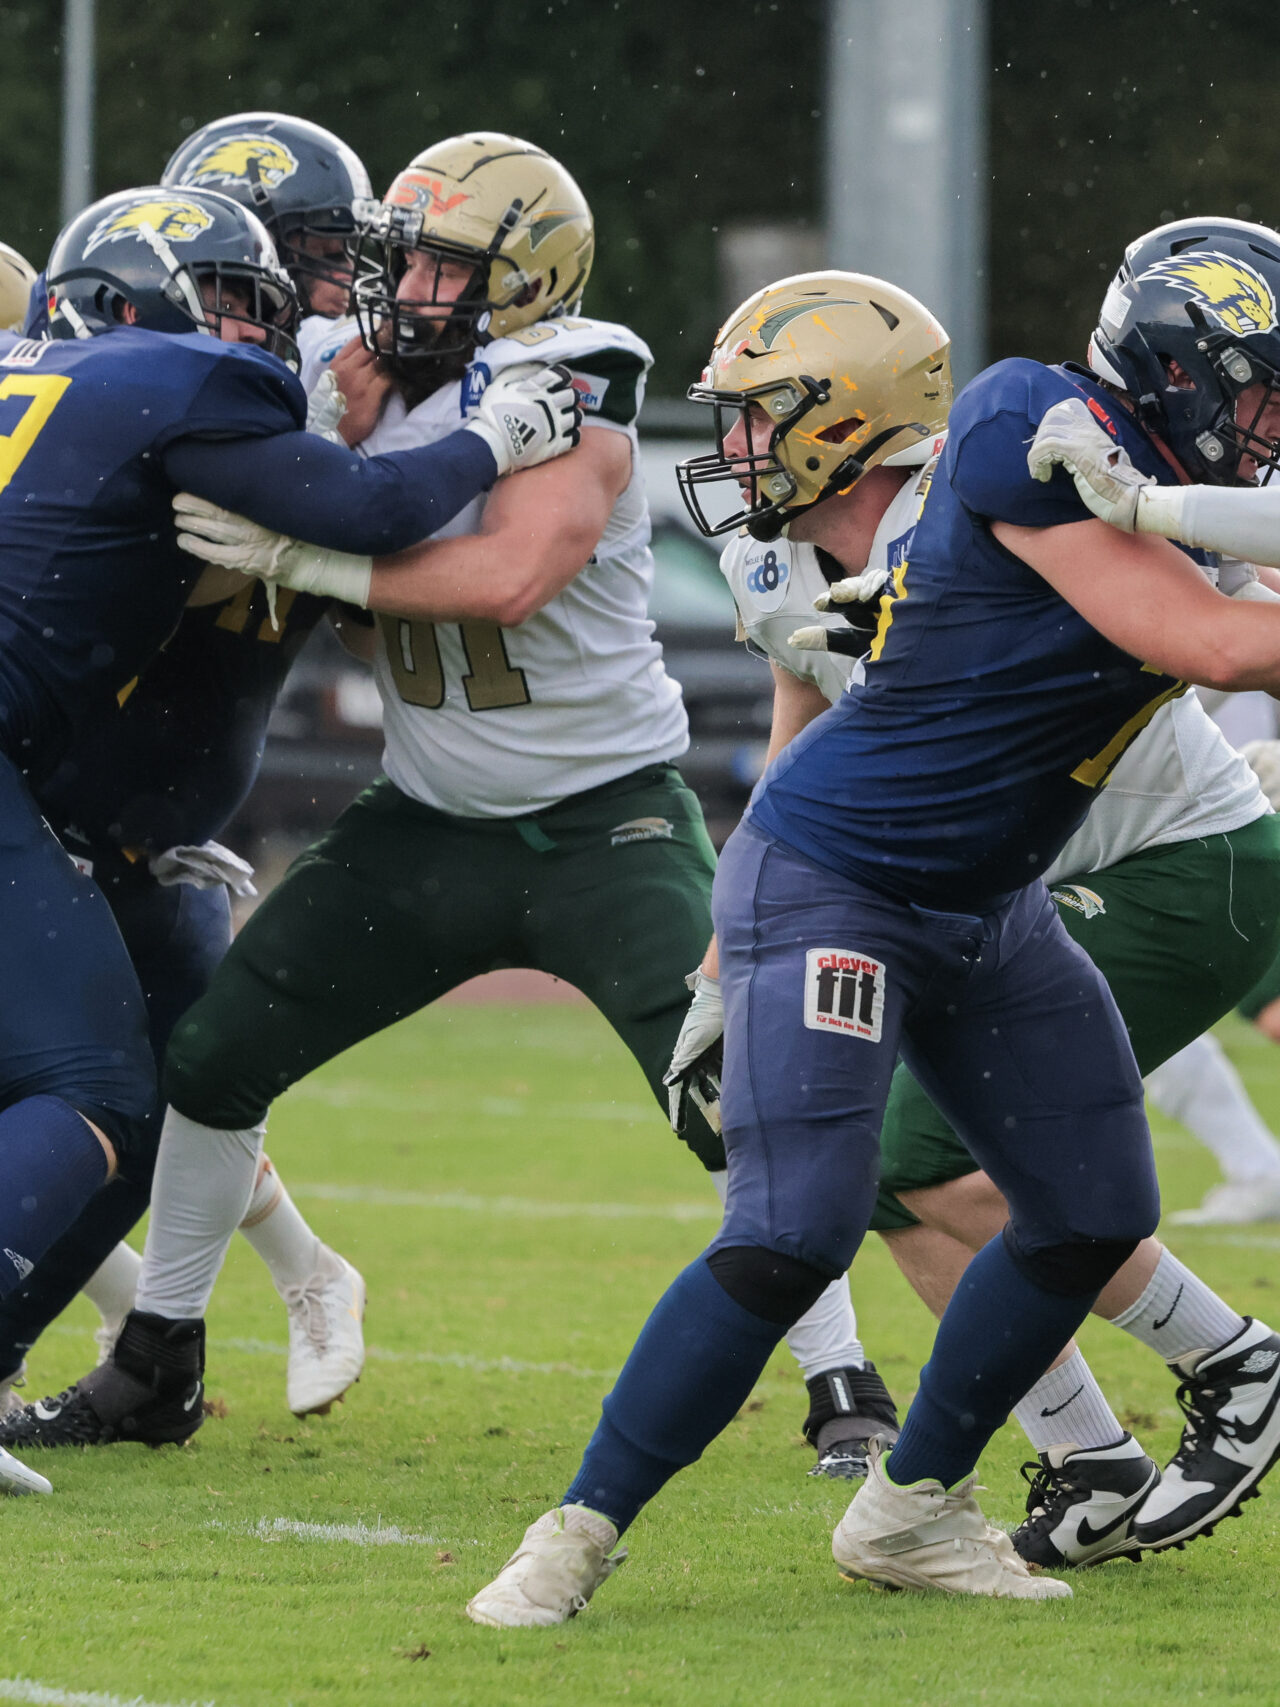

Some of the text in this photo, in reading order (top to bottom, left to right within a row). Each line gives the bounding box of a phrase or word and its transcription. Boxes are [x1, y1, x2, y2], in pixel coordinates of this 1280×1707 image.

[503, 414, 523, 456] adidas
[817, 953, 879, 975] clever
[816, 967, 877, 1027] fit
